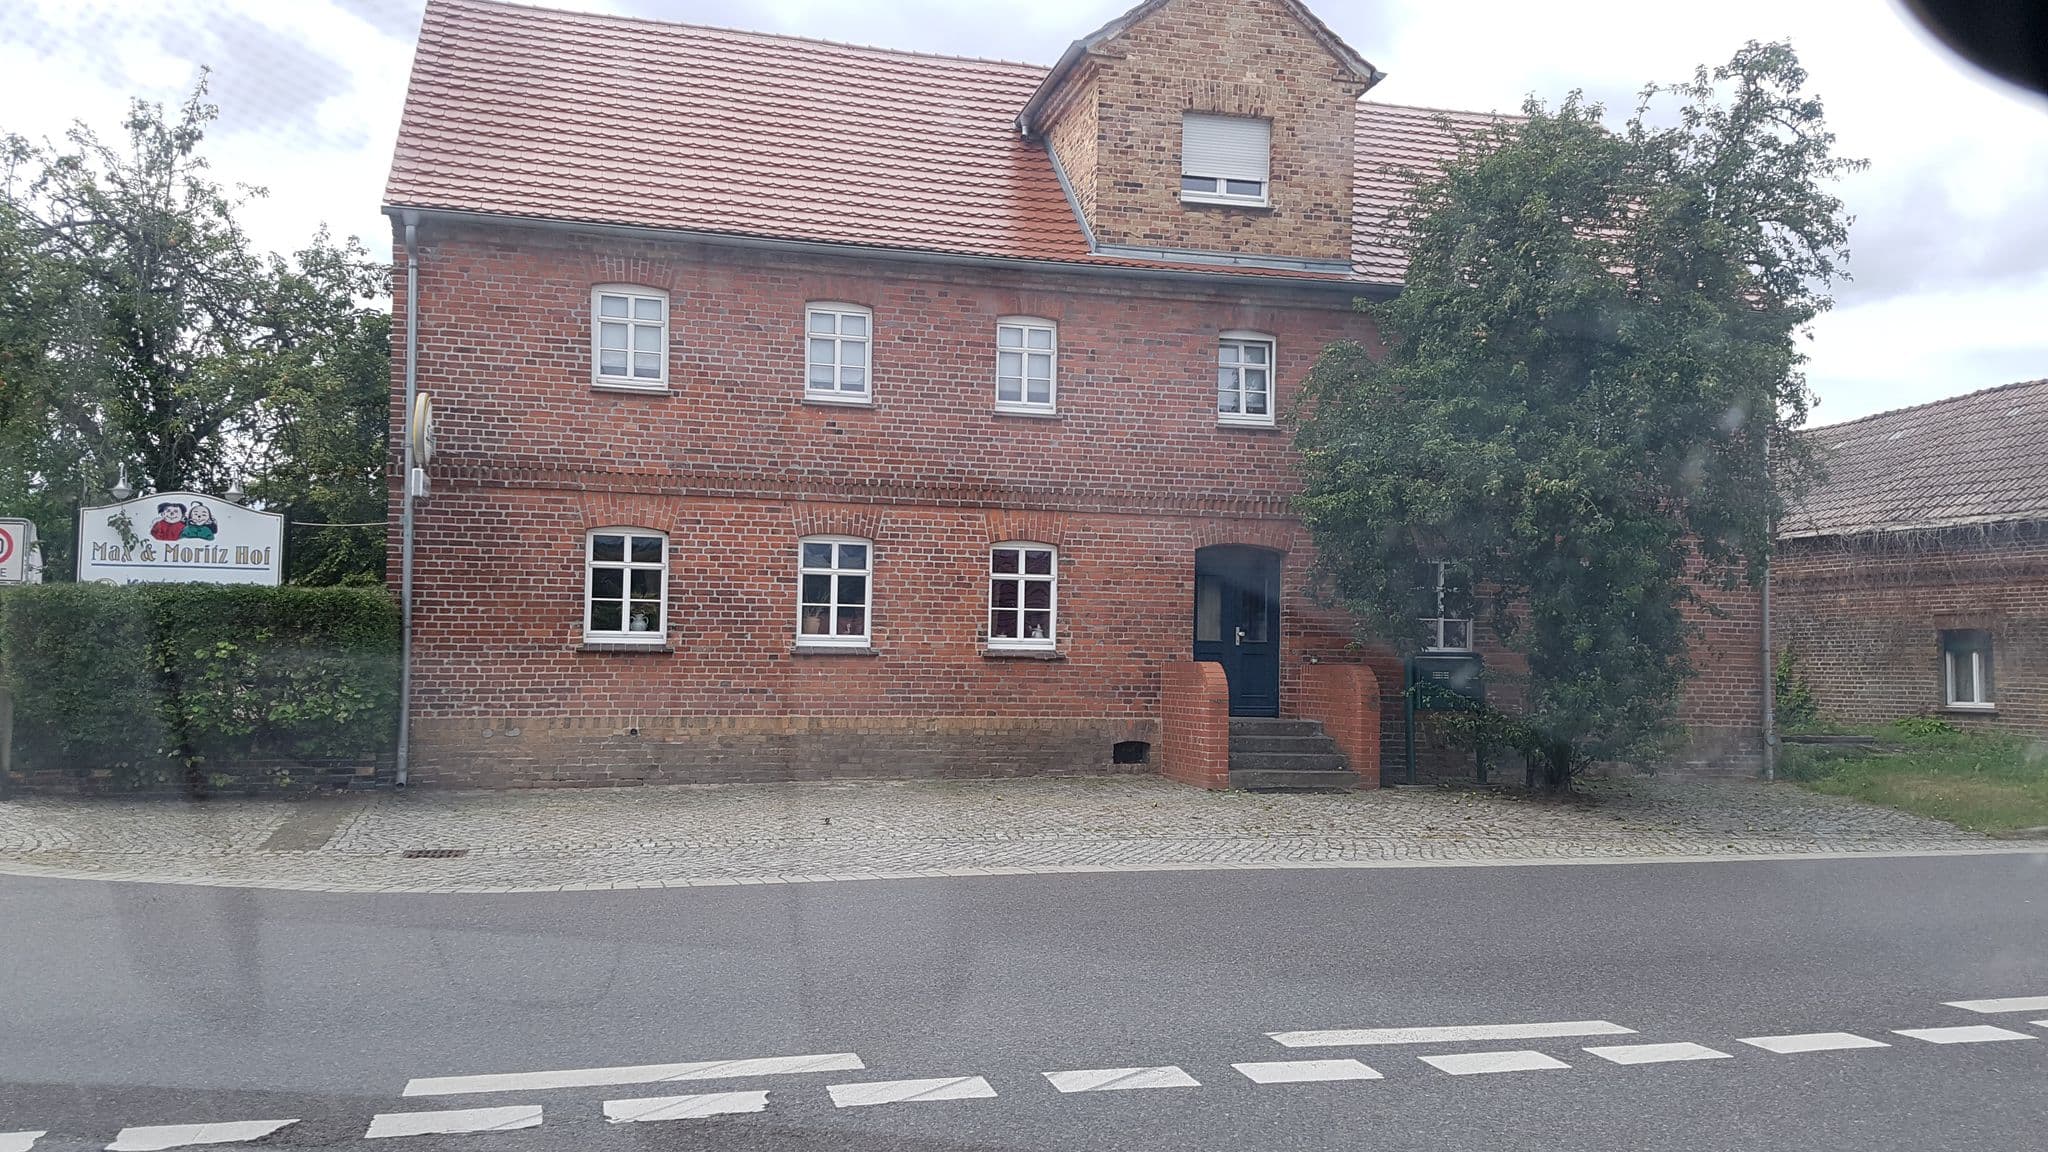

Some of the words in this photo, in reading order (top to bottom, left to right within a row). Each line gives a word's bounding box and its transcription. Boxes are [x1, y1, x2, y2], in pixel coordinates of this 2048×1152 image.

[92, 541, 132, 562] Max
[140, 543, 156, 562] &
[163, 543, 228, 563] Moritz
[235, 545, 271, 565] Hof
